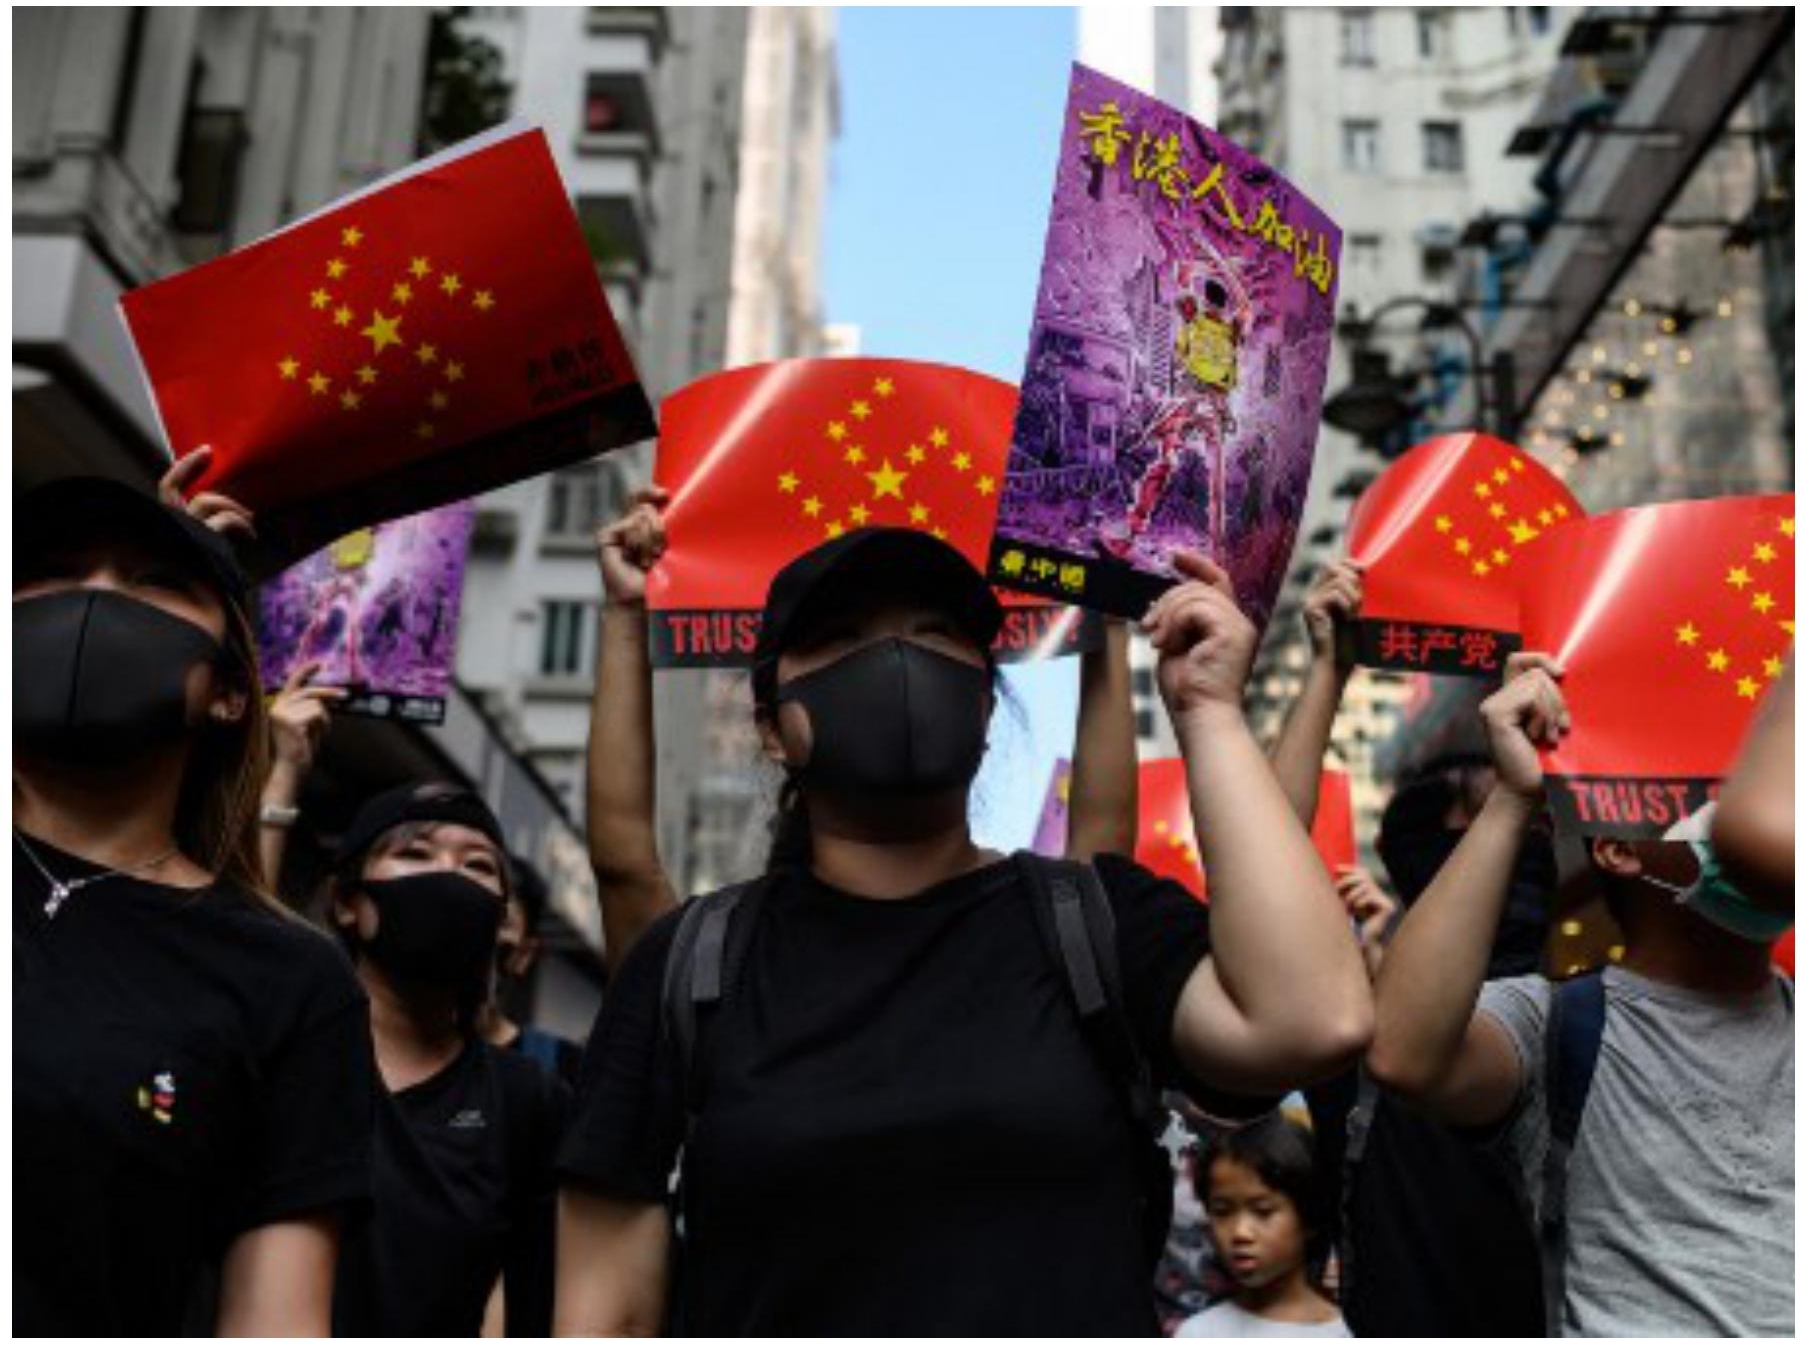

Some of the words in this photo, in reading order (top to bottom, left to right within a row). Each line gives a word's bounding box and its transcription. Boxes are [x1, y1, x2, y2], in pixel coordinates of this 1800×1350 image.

[668, 613, 762, 652] TRUS
[1380, 624, 1498, 670] 共产党
[1567, 780, 1690, 825] TRUST
